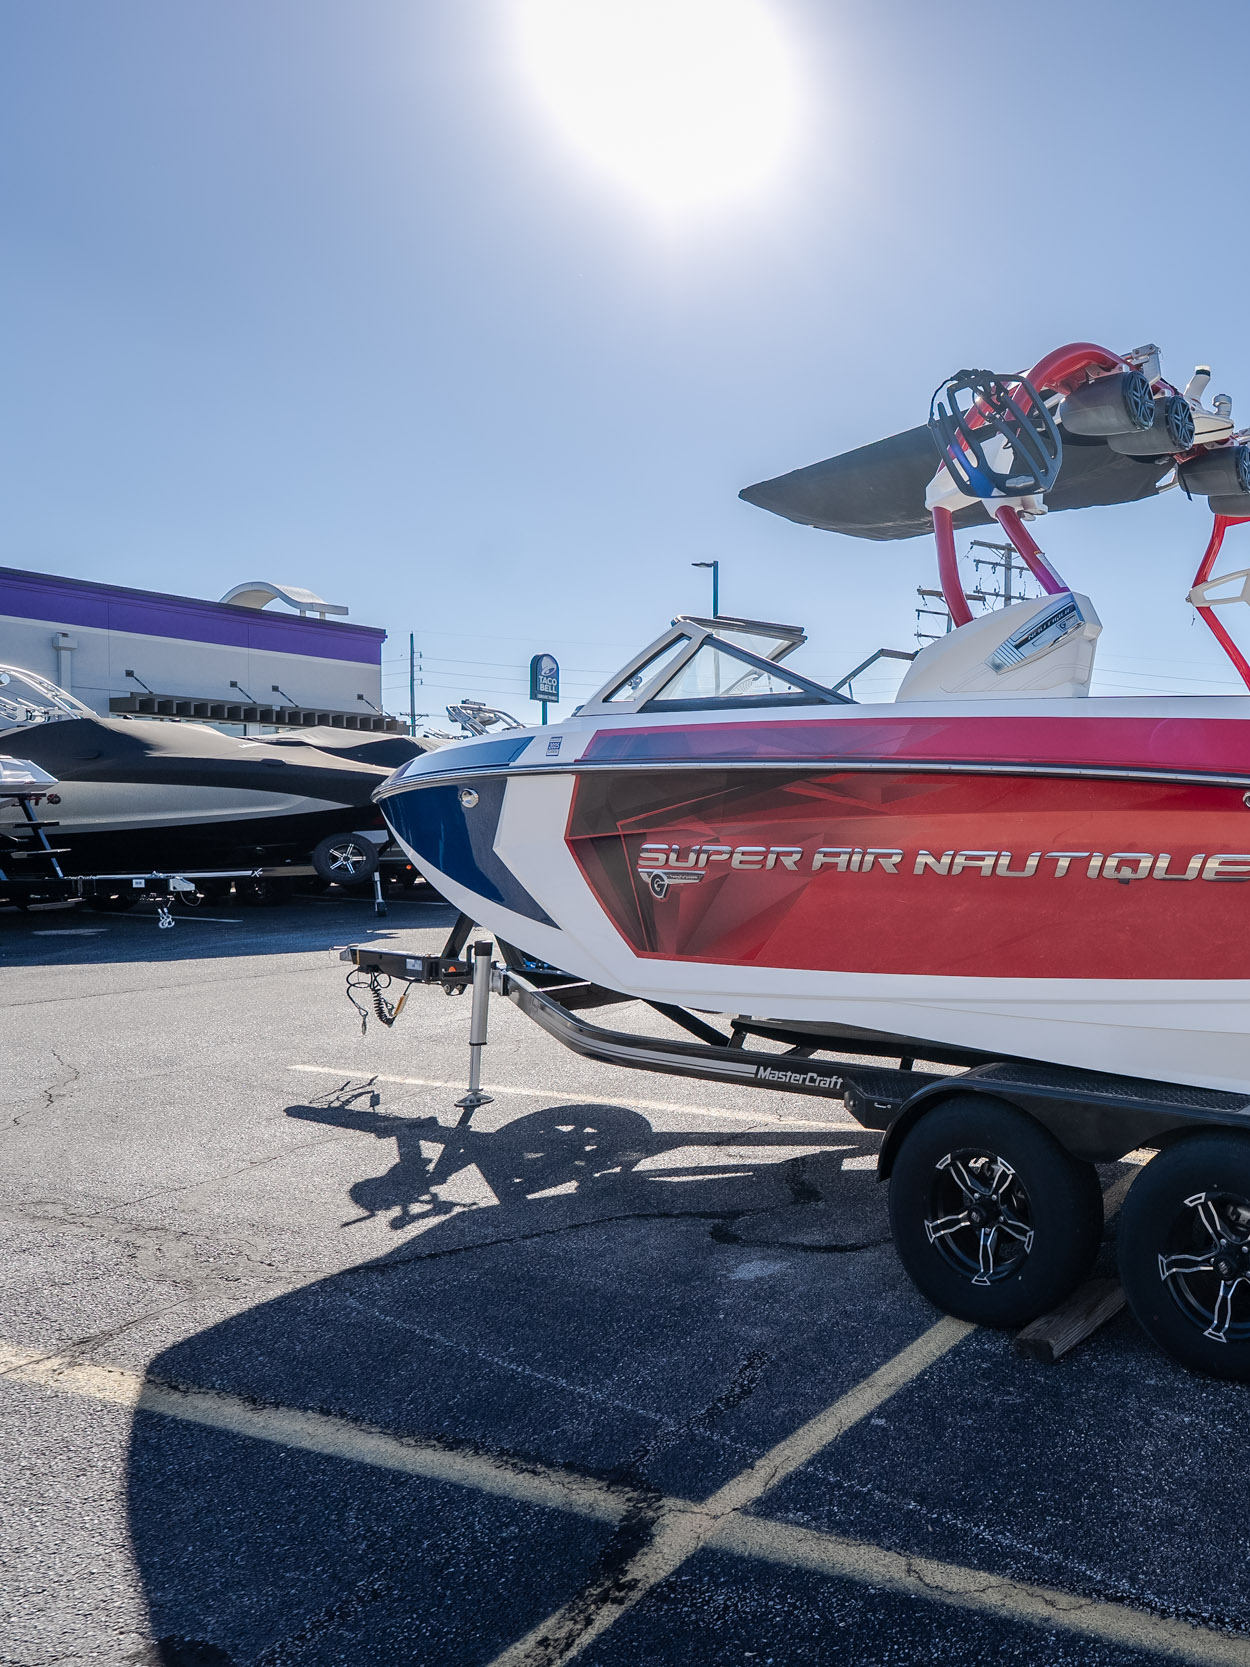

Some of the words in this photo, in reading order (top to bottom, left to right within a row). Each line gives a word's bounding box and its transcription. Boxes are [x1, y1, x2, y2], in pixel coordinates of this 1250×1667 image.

[539, 676, 557, 686] TACO
[540, 684, 557, 693] BELL
[638, 844, 803, 871] SUPER
[811, 848, 903, 874] AIR
[757, 1066, 843, 1089] MasterCraft
